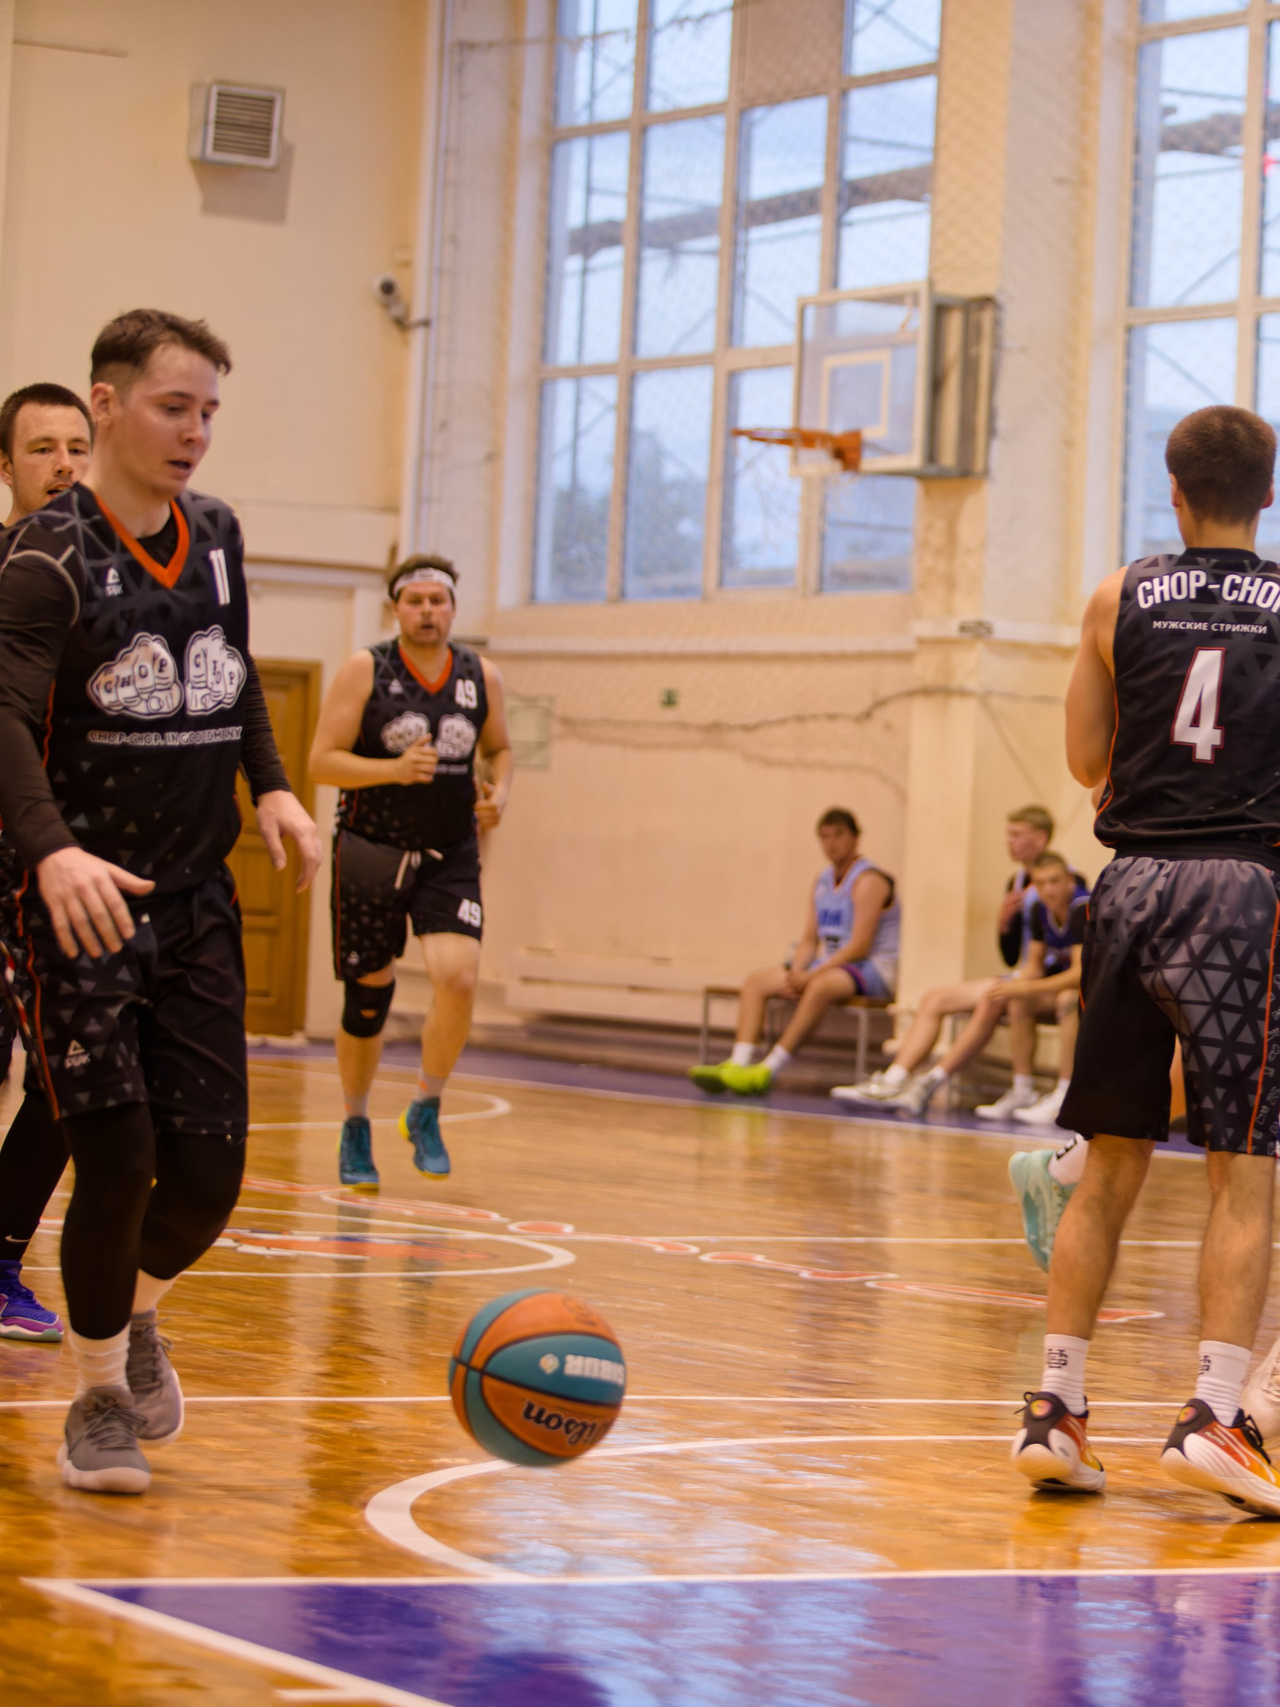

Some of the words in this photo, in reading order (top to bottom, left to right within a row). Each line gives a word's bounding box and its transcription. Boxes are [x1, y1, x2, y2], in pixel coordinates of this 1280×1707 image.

[209, 549, 230, 605] 11
[1152, 620, 1208, 631] МУЖСКИЕ
[1210, 623, 1267, 634] СТРИЖКИ
[455, 679, 477, 709] 49
[1170, 647, 1226, 763] 4
[457, 898, 481, 928] 49
[522, 1400, 606, 1446] ilson
